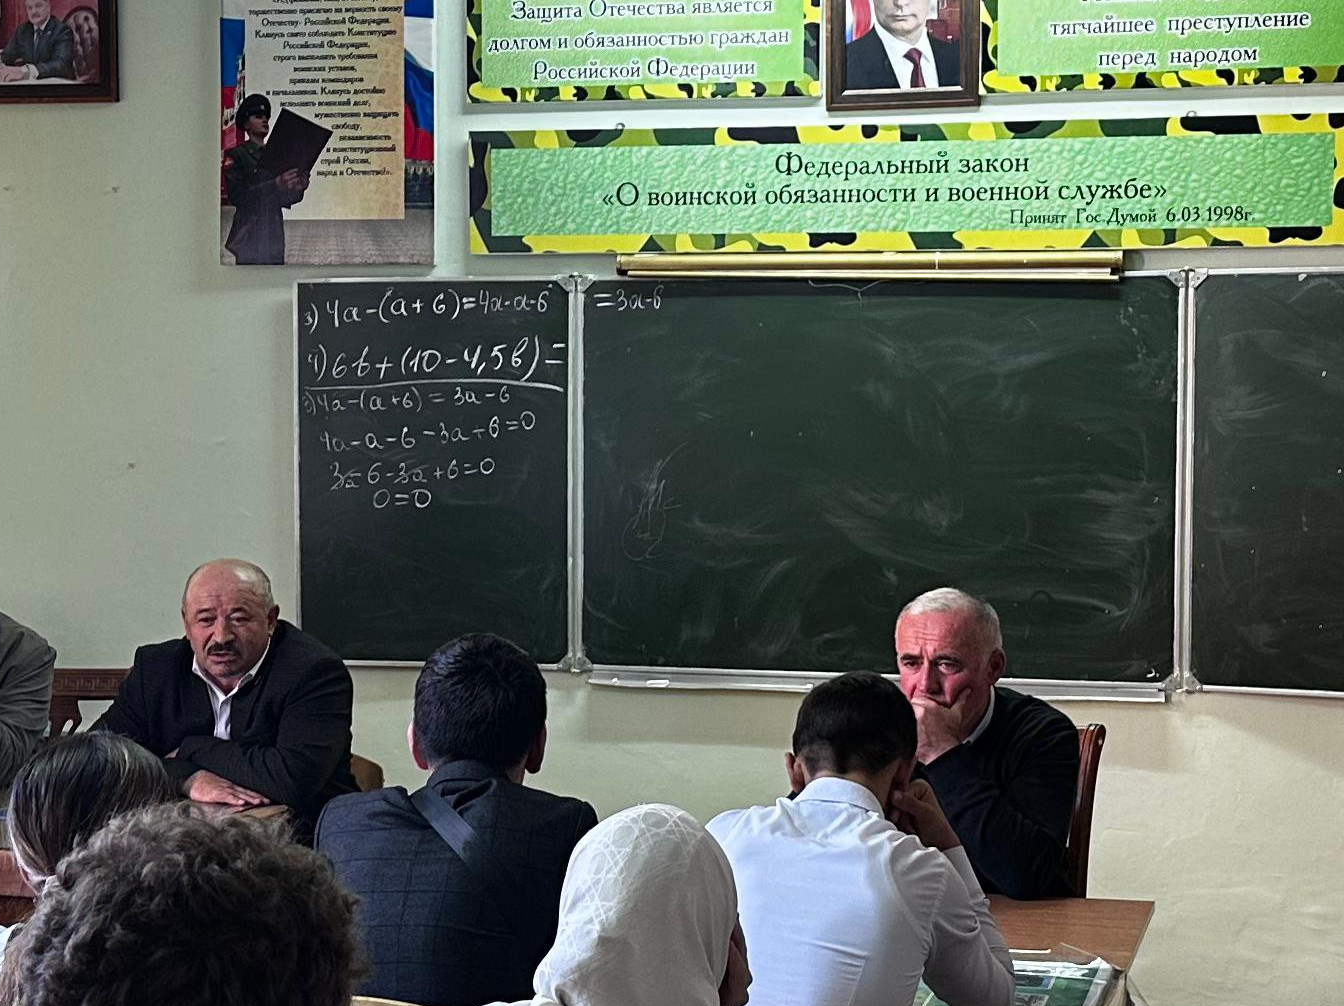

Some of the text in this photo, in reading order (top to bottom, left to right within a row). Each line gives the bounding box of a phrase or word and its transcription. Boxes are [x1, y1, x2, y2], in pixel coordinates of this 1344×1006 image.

[510, 0, 773, 23] Защита Отечества является
[1049, 11, 1310, 36] тягчайшее преступление
[488, 30, 789, 53] долгом и обязанностью граждан
[1098, 47, 1258, 69] перед народом
[533, 59, 756, 81] Российской Федерации
[775, 151, 1030, 180] Федеральный закон
[602, 178, 1167, 206] «О воинской обязанности и военной службе»
[1010, 209, 1067, 227] Принят
